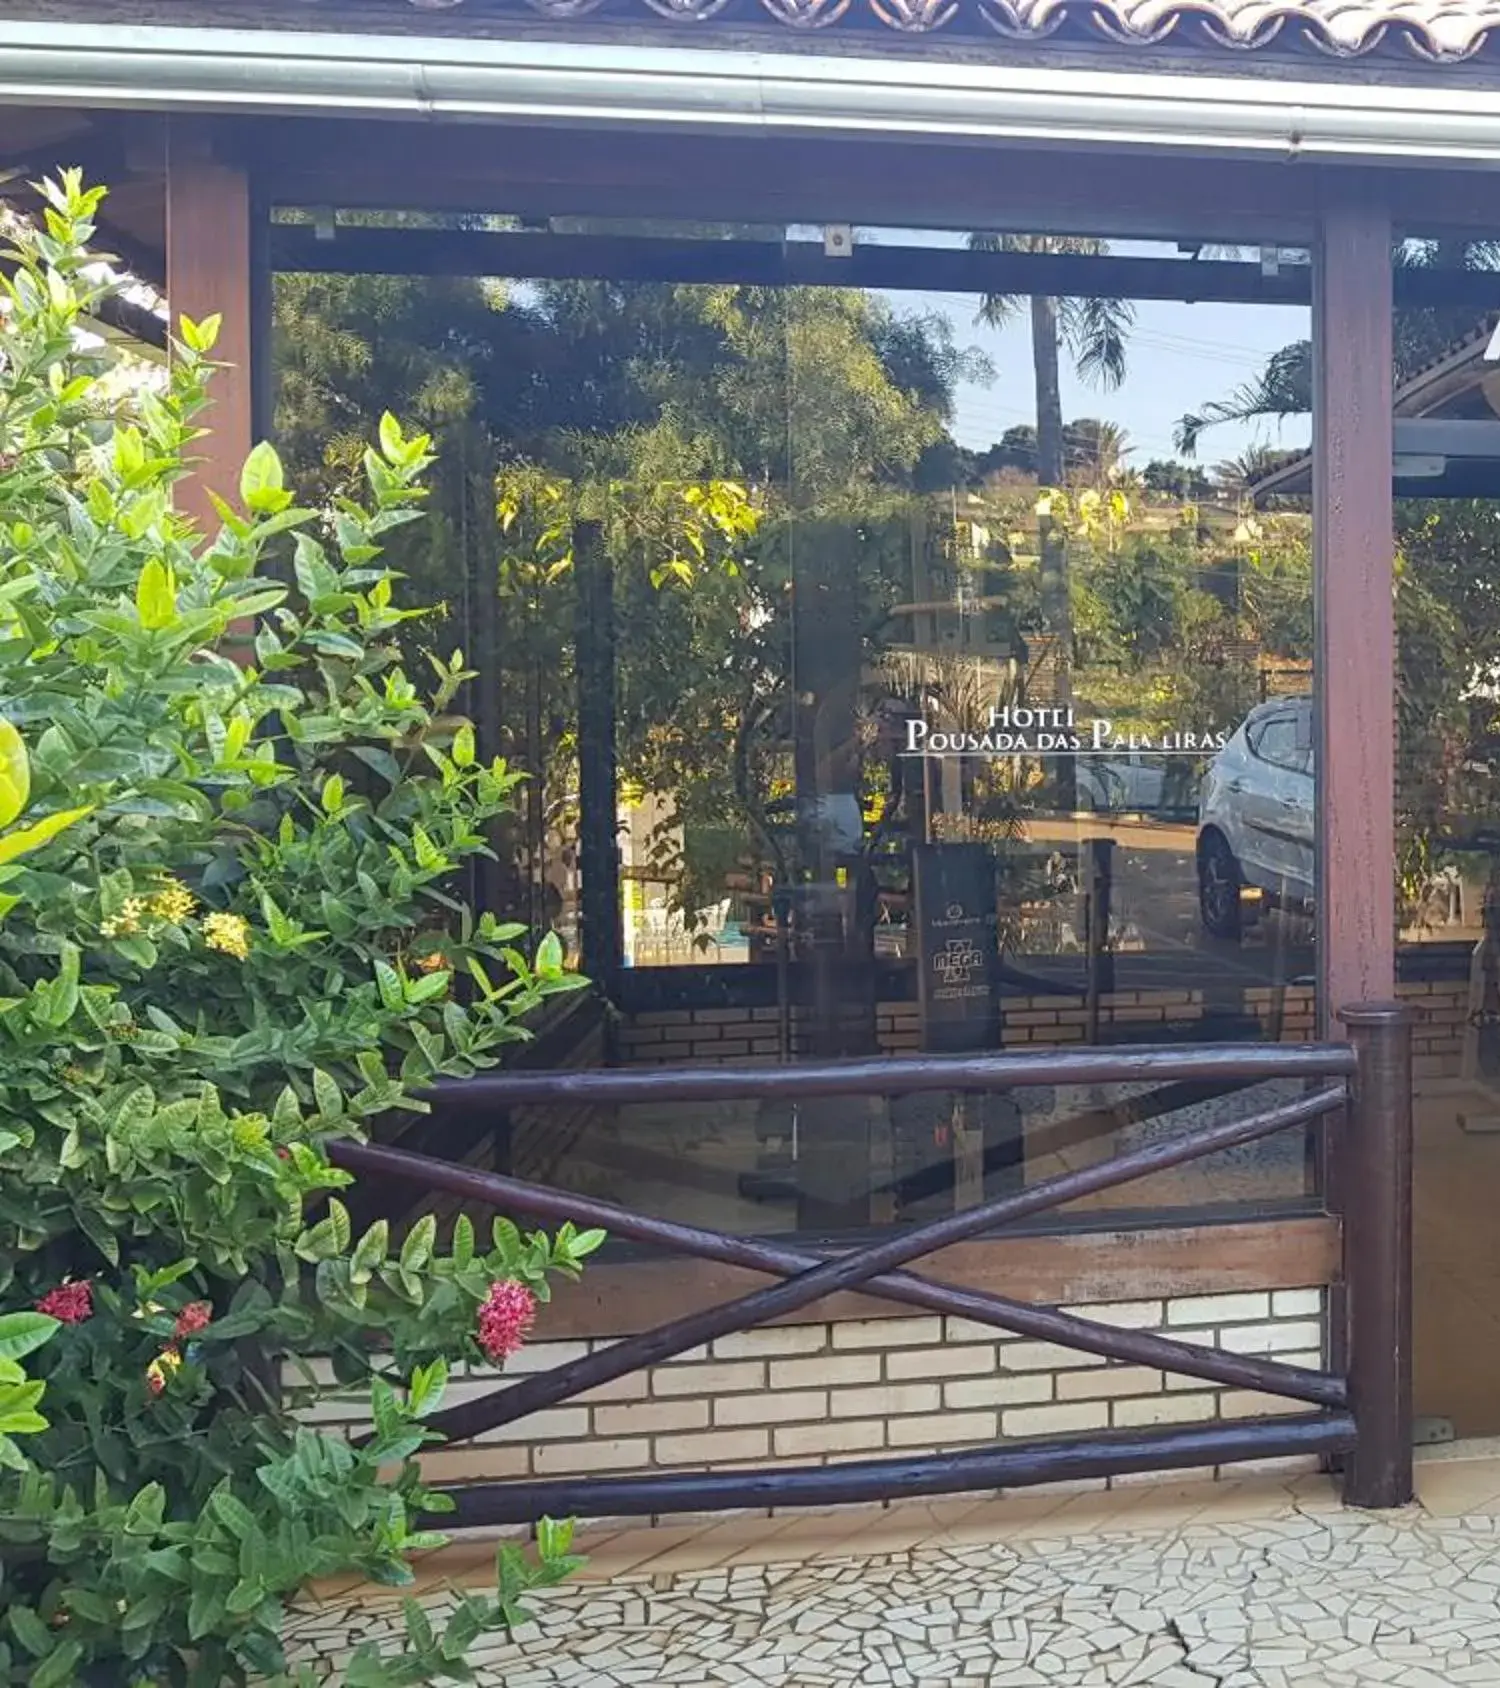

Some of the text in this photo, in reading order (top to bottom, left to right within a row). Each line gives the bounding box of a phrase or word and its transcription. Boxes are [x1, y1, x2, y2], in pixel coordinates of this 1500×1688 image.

[988, 705, 1075, 728] HOTEL
[904, 719, 1029, 751] POUSADA
[1036, 732, 1081, 751] DAS
